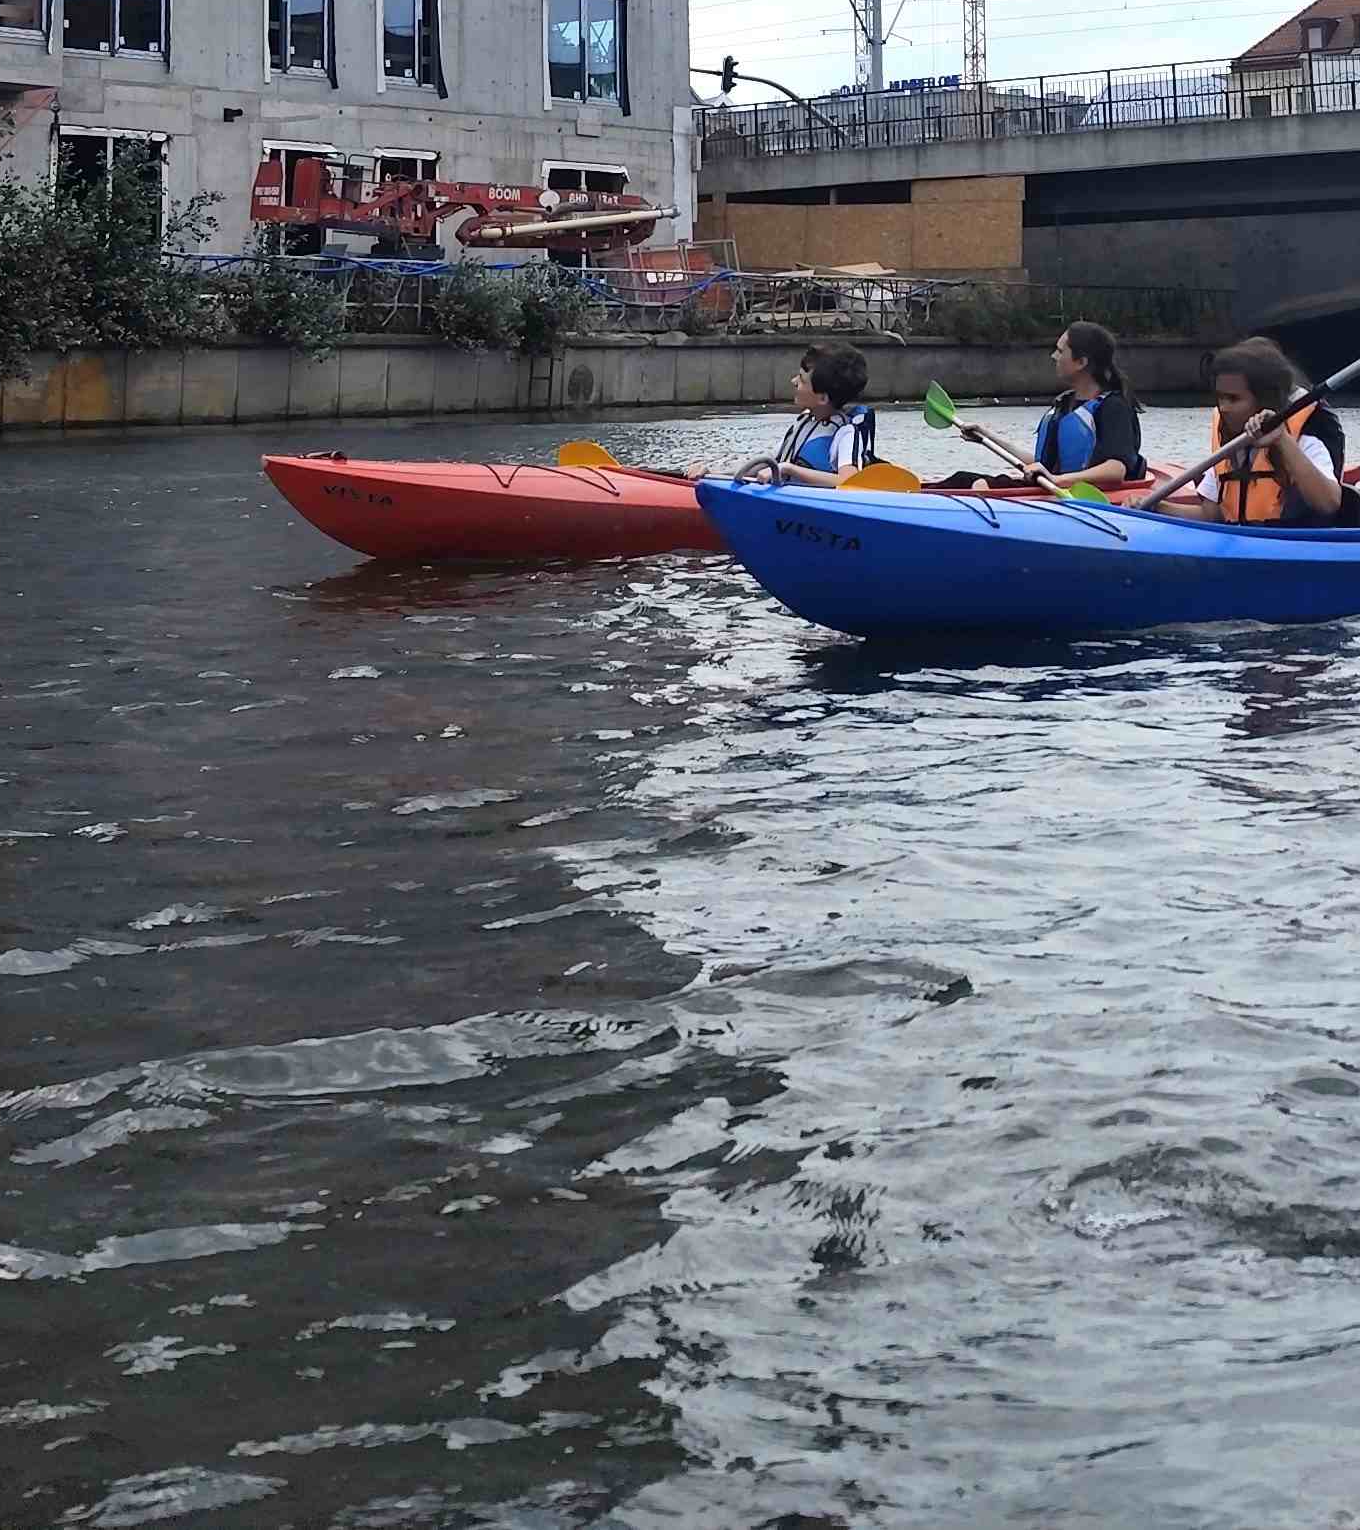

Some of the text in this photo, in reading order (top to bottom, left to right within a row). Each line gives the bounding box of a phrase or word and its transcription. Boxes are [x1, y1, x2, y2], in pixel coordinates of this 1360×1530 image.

[488, 186, 521, 202] BOOM
[321, 484, 394, 507] VISTA
[774, 518, 863, 551] VISTA
